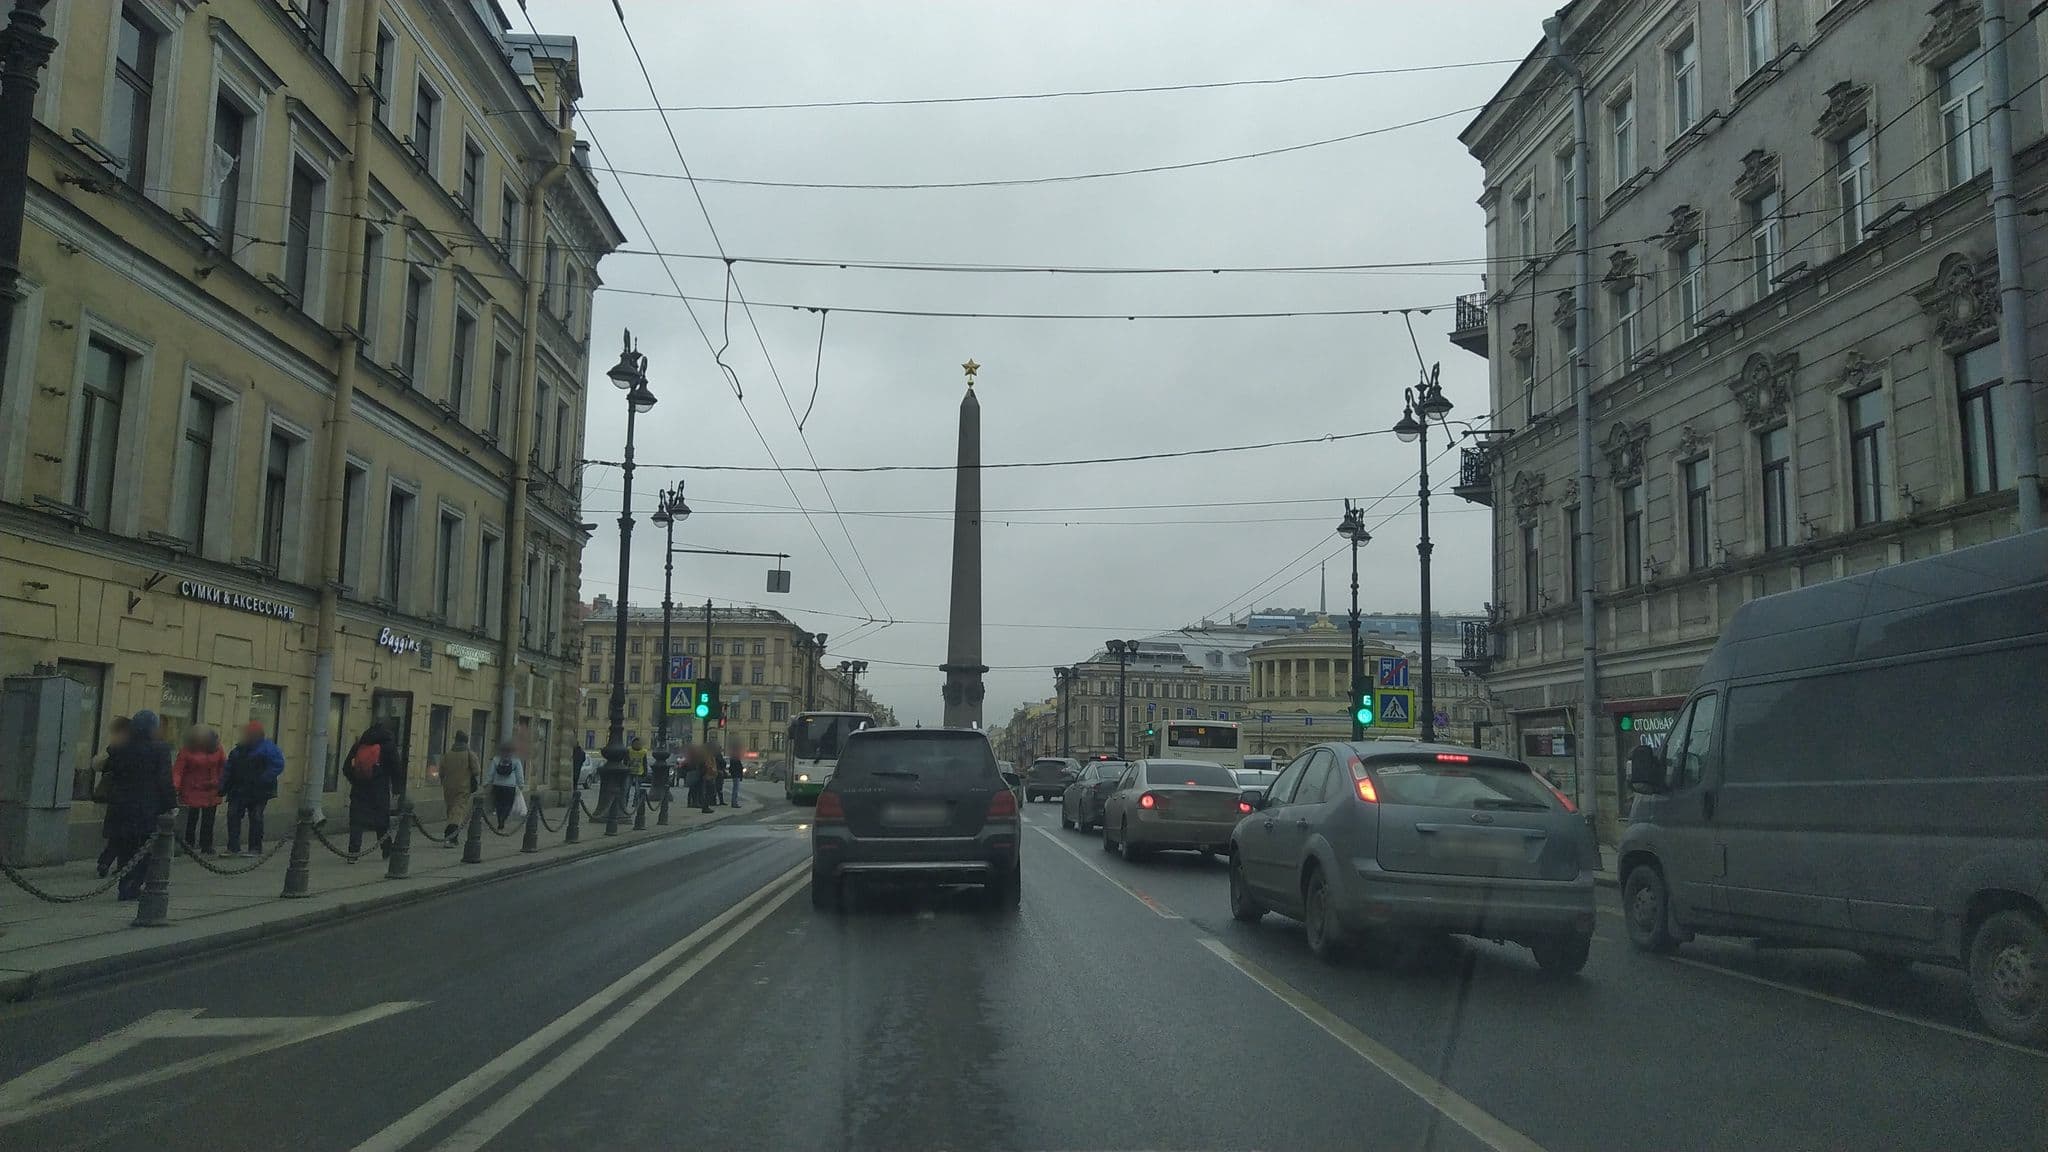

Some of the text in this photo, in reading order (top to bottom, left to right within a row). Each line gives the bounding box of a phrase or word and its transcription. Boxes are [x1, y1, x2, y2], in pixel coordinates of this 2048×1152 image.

[182, 581, 295, 619] СУМКИ & АКСЕССУАРЫ
[380, 627, 421, 654] Baggins
